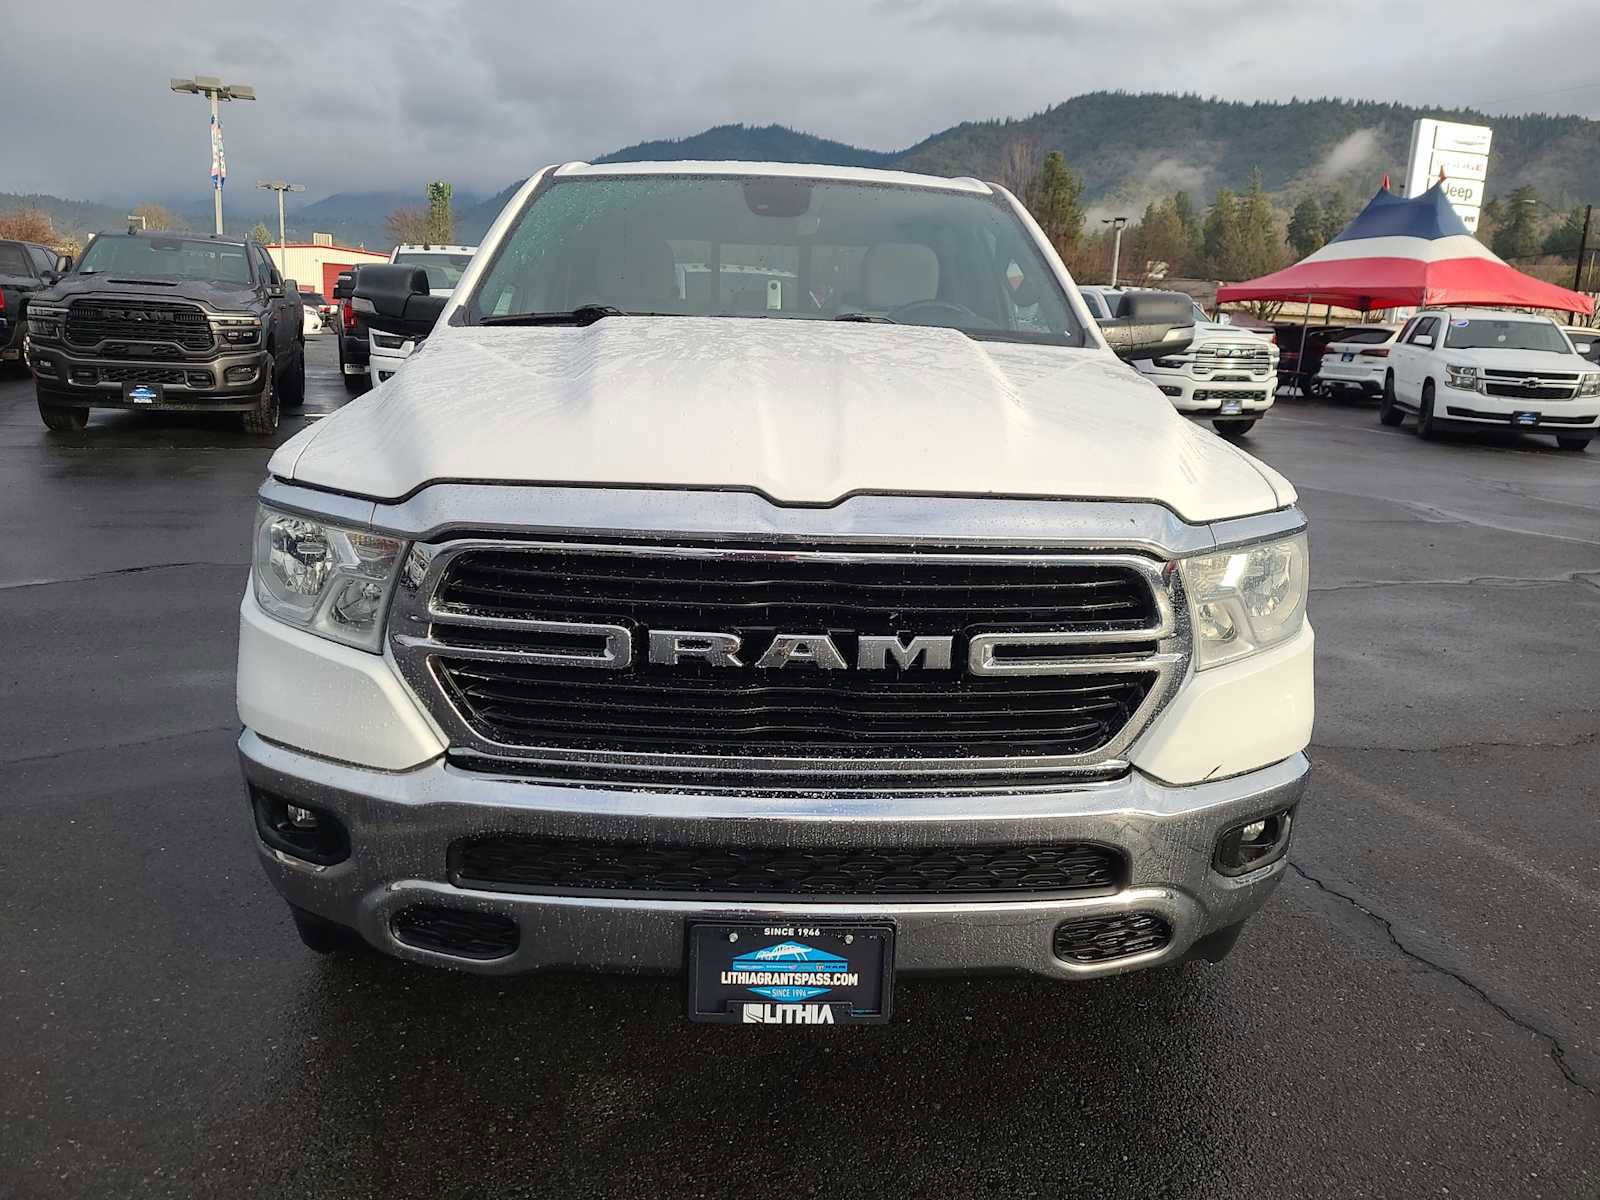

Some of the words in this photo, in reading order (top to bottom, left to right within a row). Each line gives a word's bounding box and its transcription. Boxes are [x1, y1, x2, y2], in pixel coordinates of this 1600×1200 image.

[1446, 183, 1473, 201] Jeep
[104, 309, 174, 321] RAM
[648, 629, 953, 670] RAM
[763, 927, 795, 937] SINCE
[797, 928, 821, 938] 1946
[720, 971, 859, 986] LITHIAGRANTSPASS.COM
[772, 988, 790, 997] SINCE
[764, 1003, 835, 1025] LITHIA
